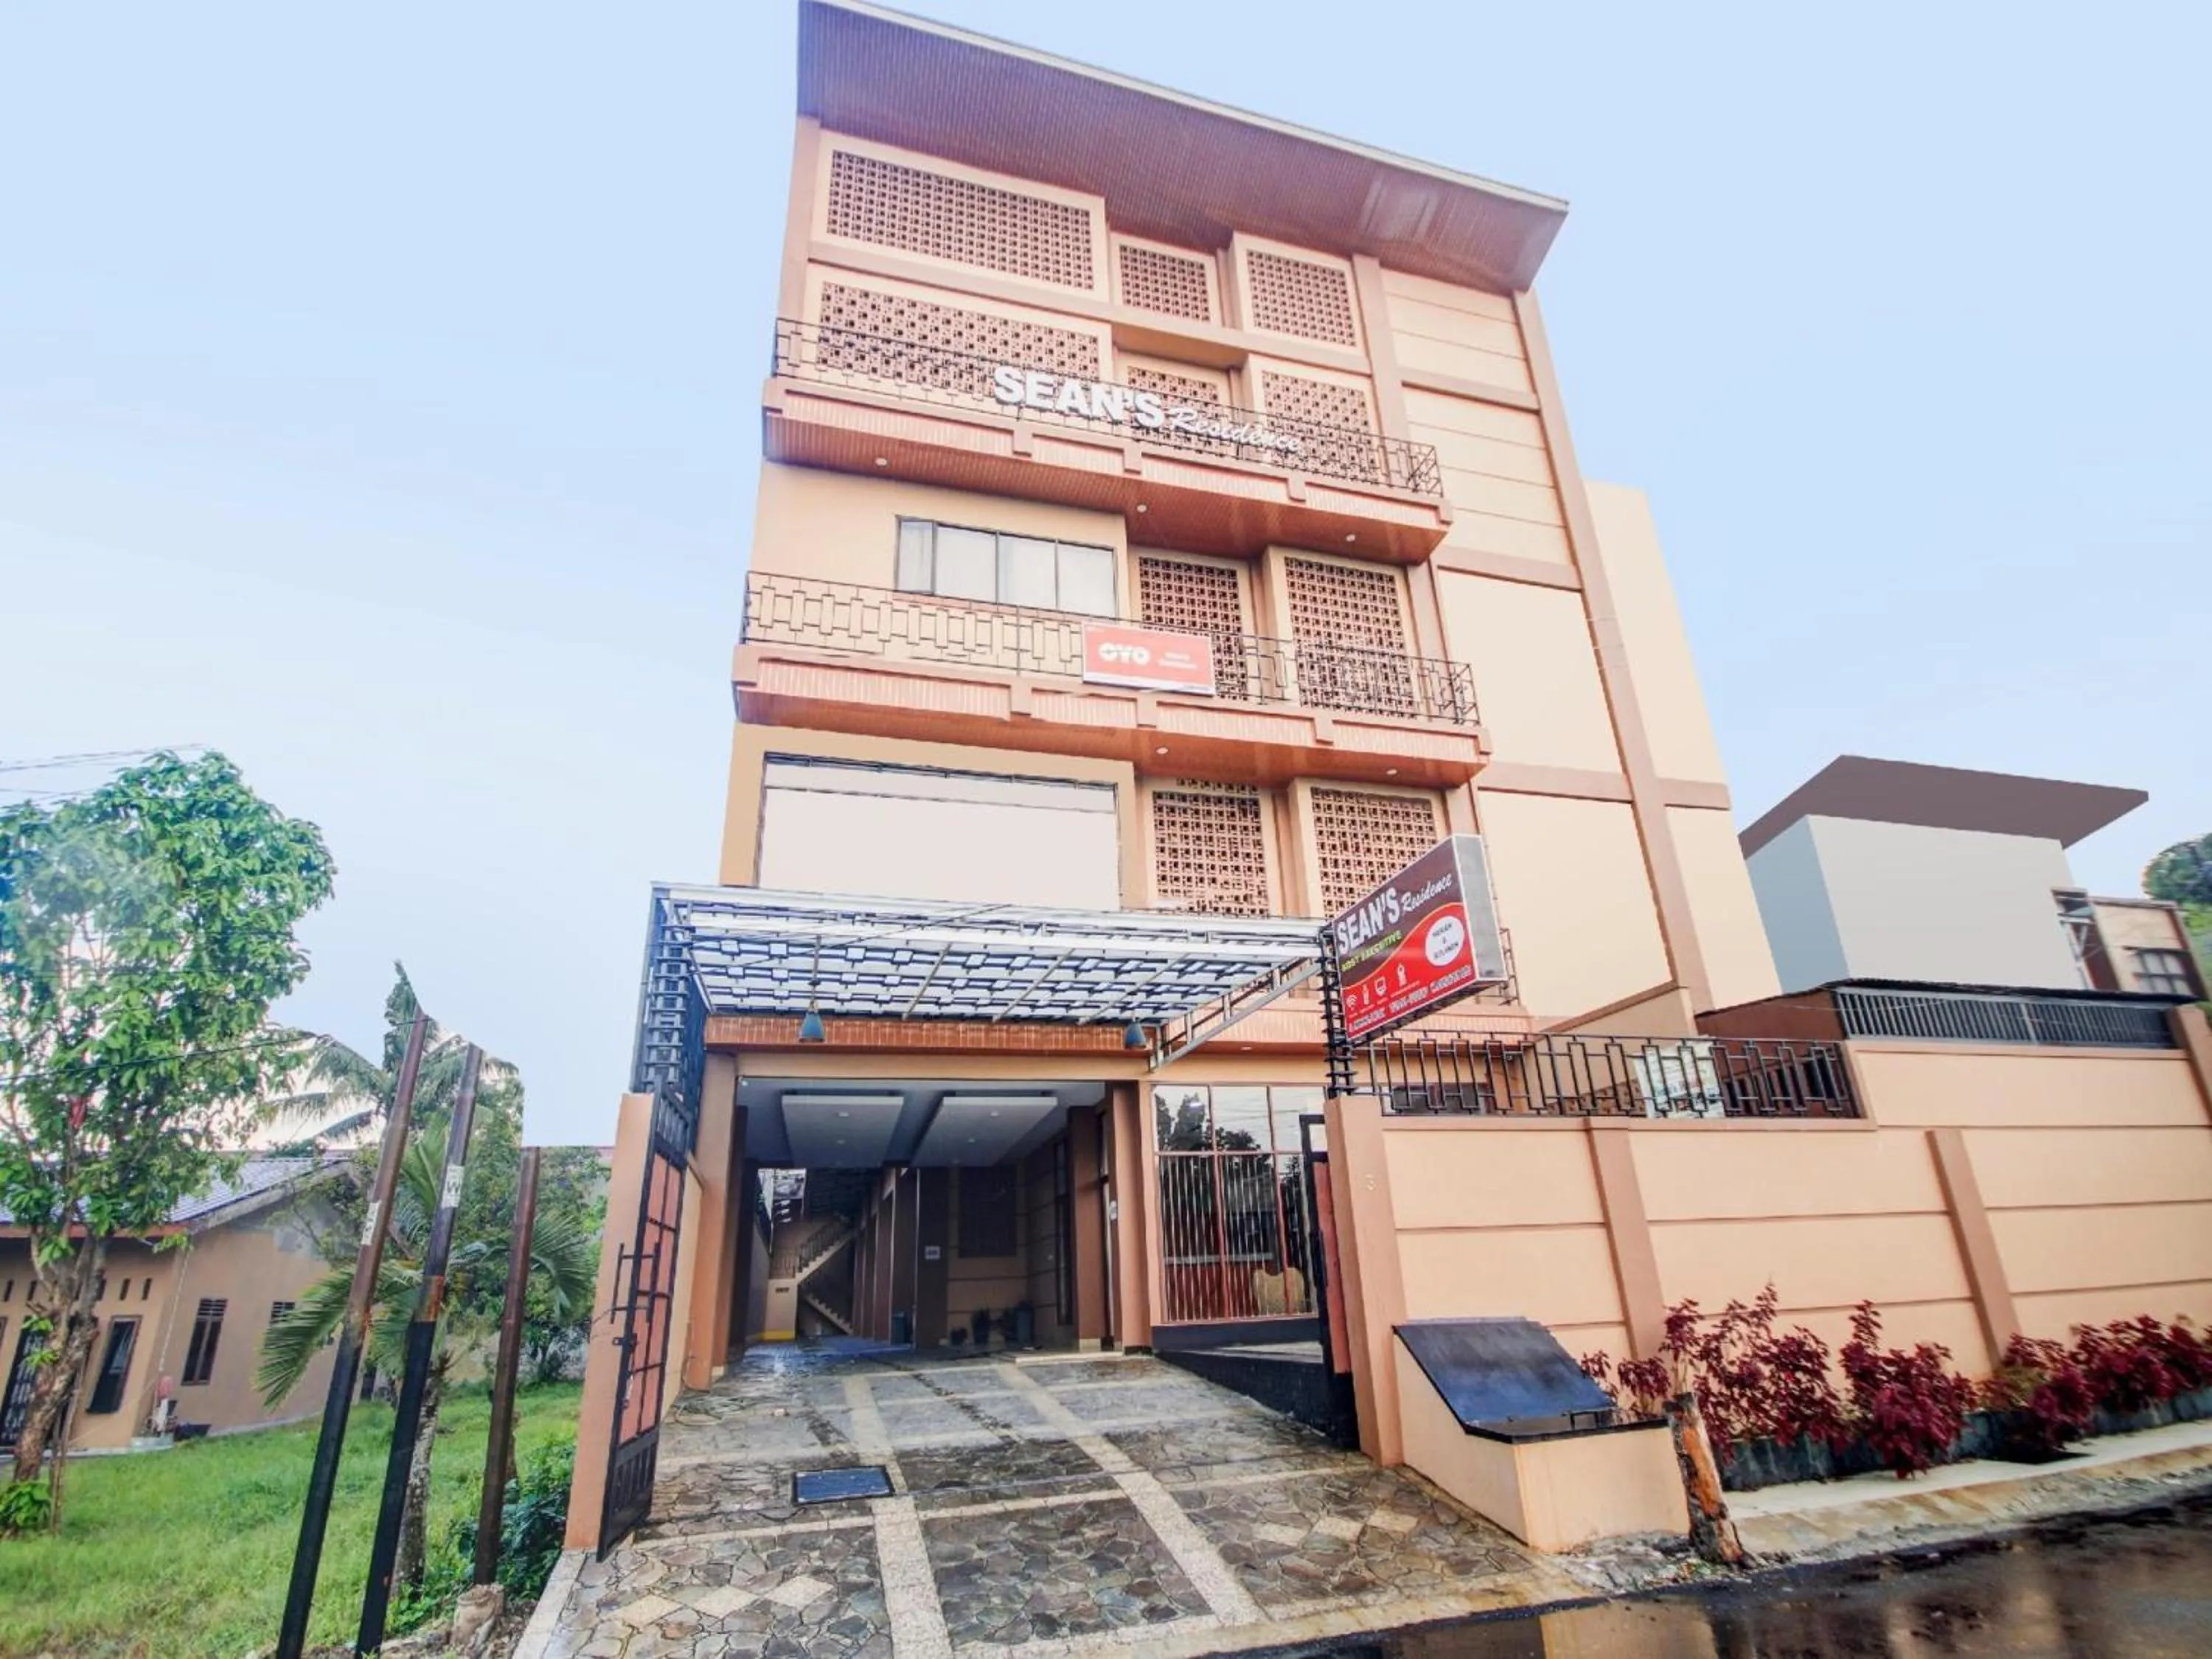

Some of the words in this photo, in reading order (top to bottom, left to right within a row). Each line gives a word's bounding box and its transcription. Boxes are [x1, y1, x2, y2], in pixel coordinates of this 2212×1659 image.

[993, 365, 1165, 429] SEAN'S
[1169, 407, 1301, 451] Residence
[1336, 887, 1400, 954] SEAN'S
[1401, 873, 1452, 913] Residence
